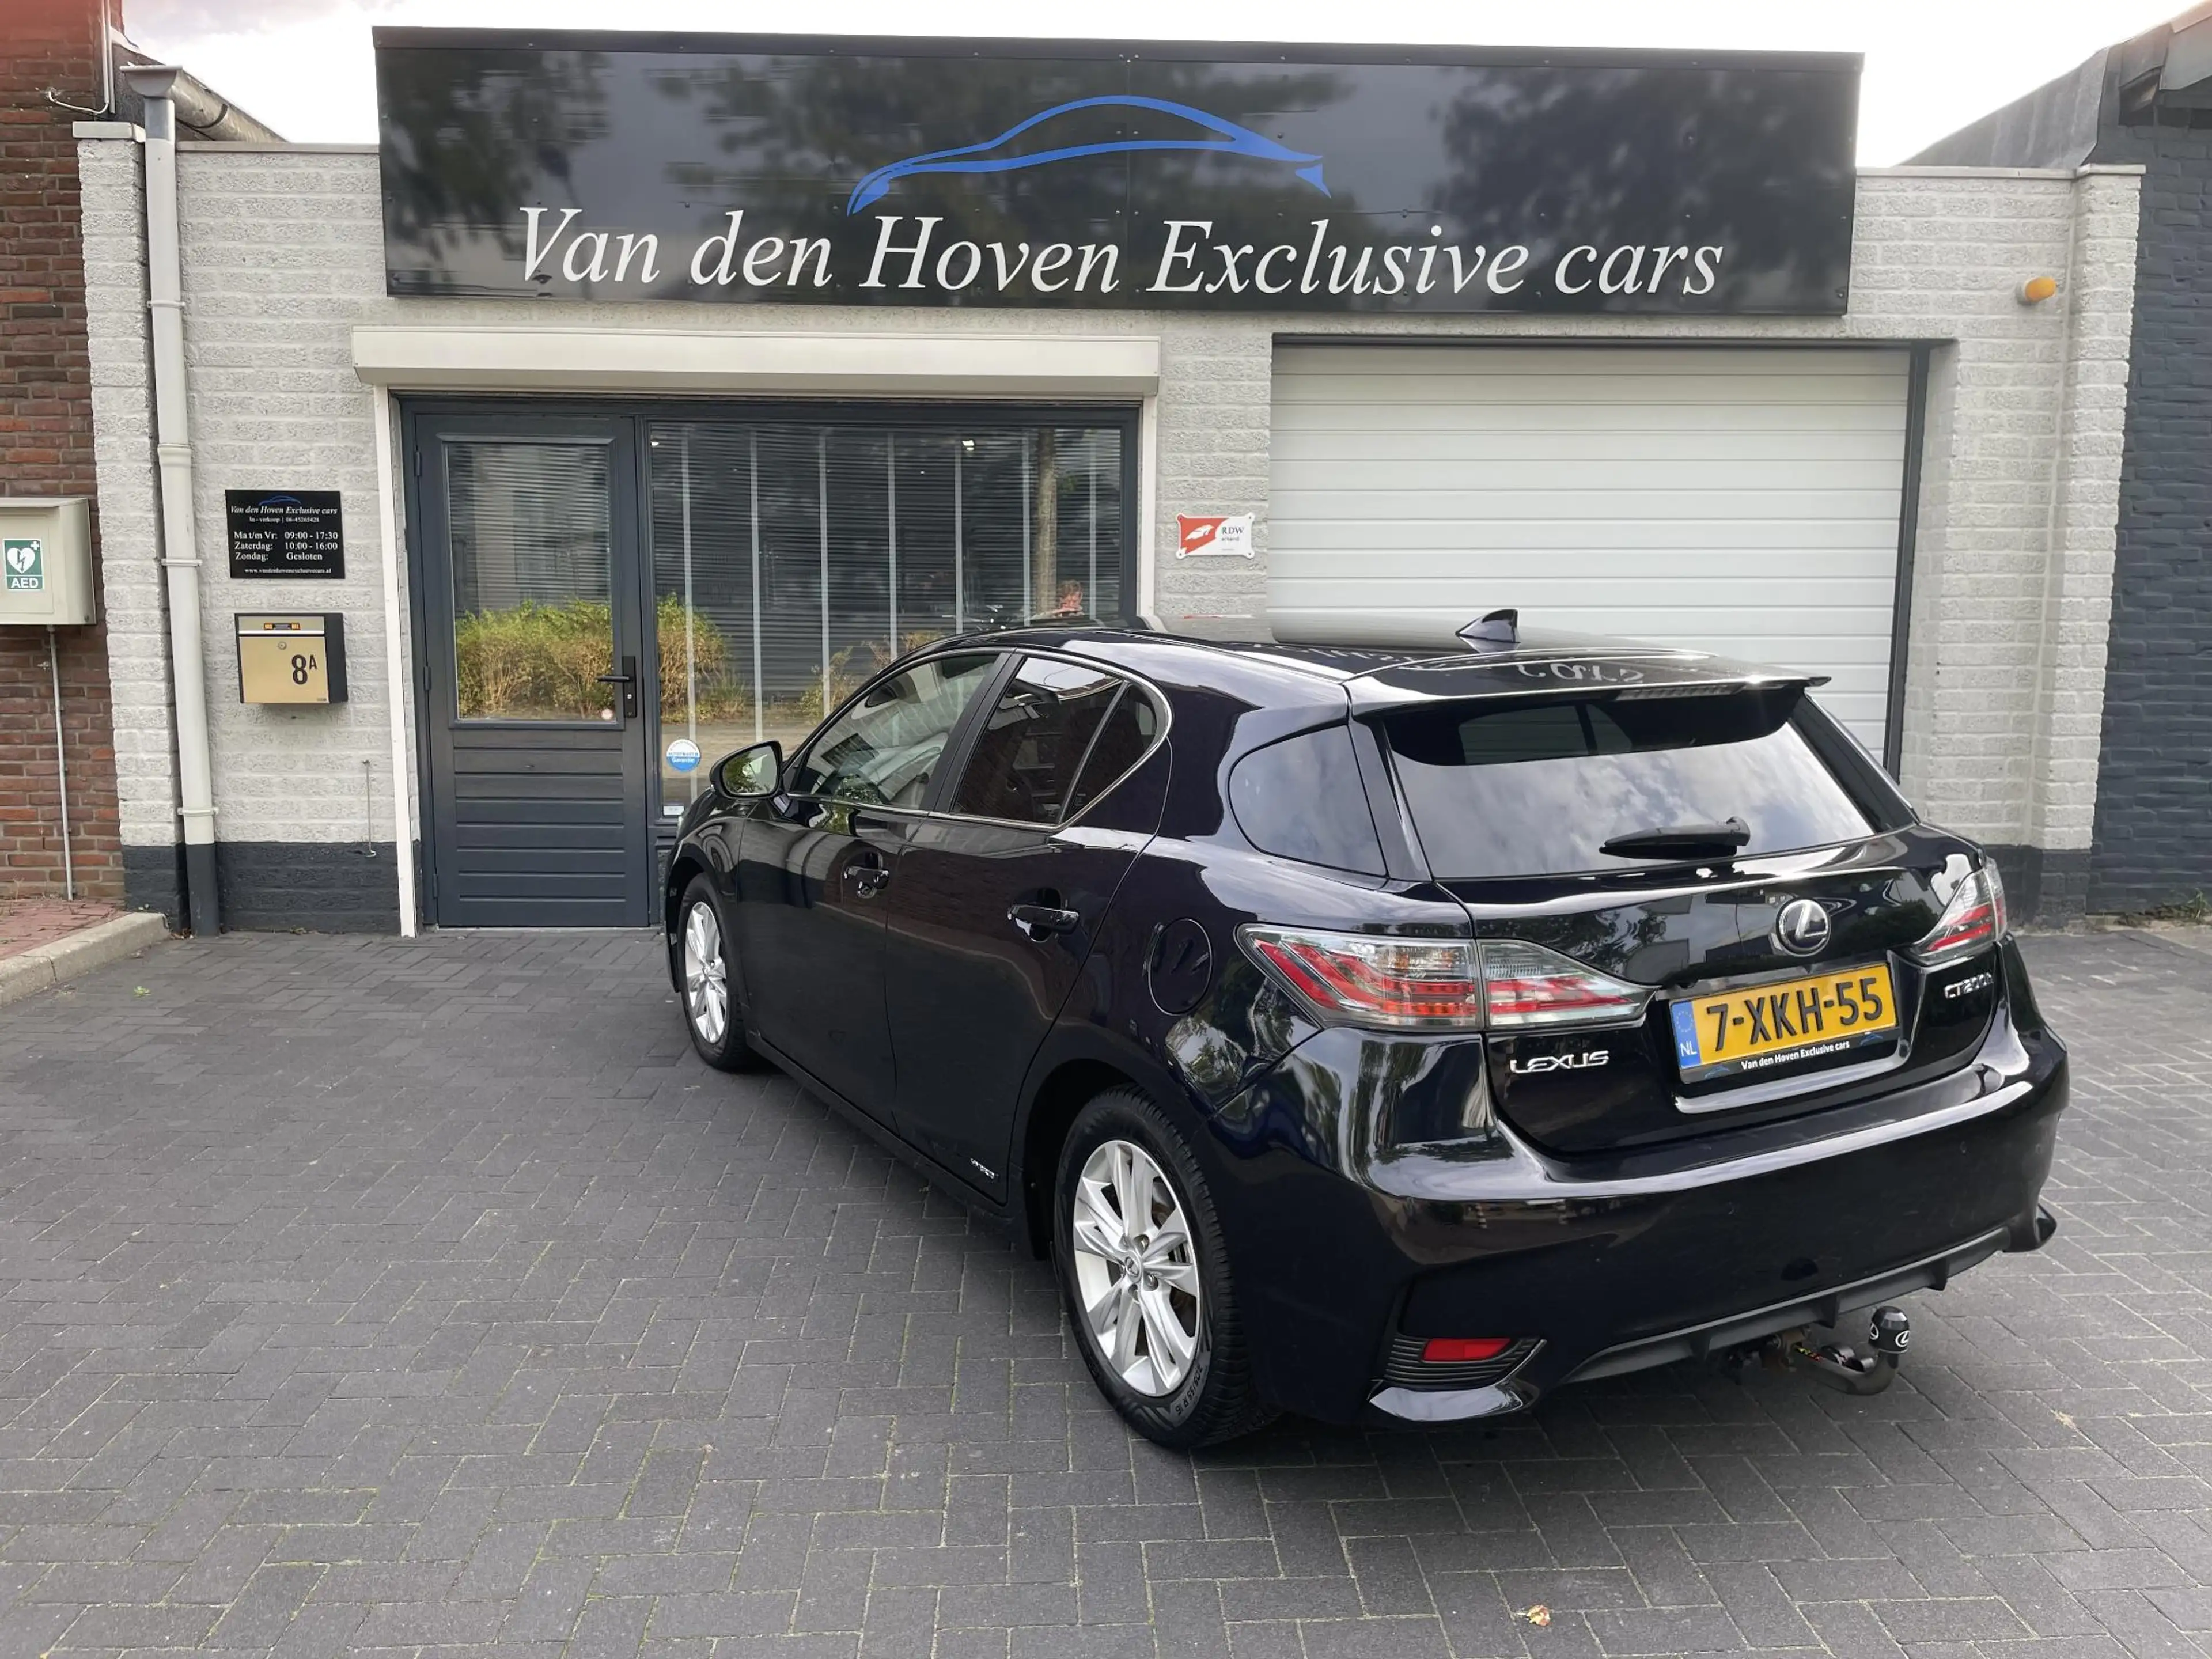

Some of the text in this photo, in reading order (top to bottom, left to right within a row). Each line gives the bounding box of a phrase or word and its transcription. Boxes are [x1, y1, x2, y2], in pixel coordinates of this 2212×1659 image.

[519, 207, 1724, 296] Van den Hoven Exclusive cars
[231, 506, 244, 514] Van
[245, 506, 259, 514] den
[260, 506, 284, 514] Hoven
[286, 506, 320, 514] Exclusive
[234, 541, 273, 551] Zaterdag:
[235, 552, 269, 562] Zondag:
[286, 552, 323, 560] Gesloten
[11, 577, 39, 588] AED
[1707, 978, 1883, 1052] 7-XKH-55
[1680, 1041, 1698, 1057] NL
[1741, 1040, 1850, 1070] Van den Hoven Exclusive cars
[1510, 1050, 1609, 1074] LEXUS
[1183, 1397, 1189, 1407] R
